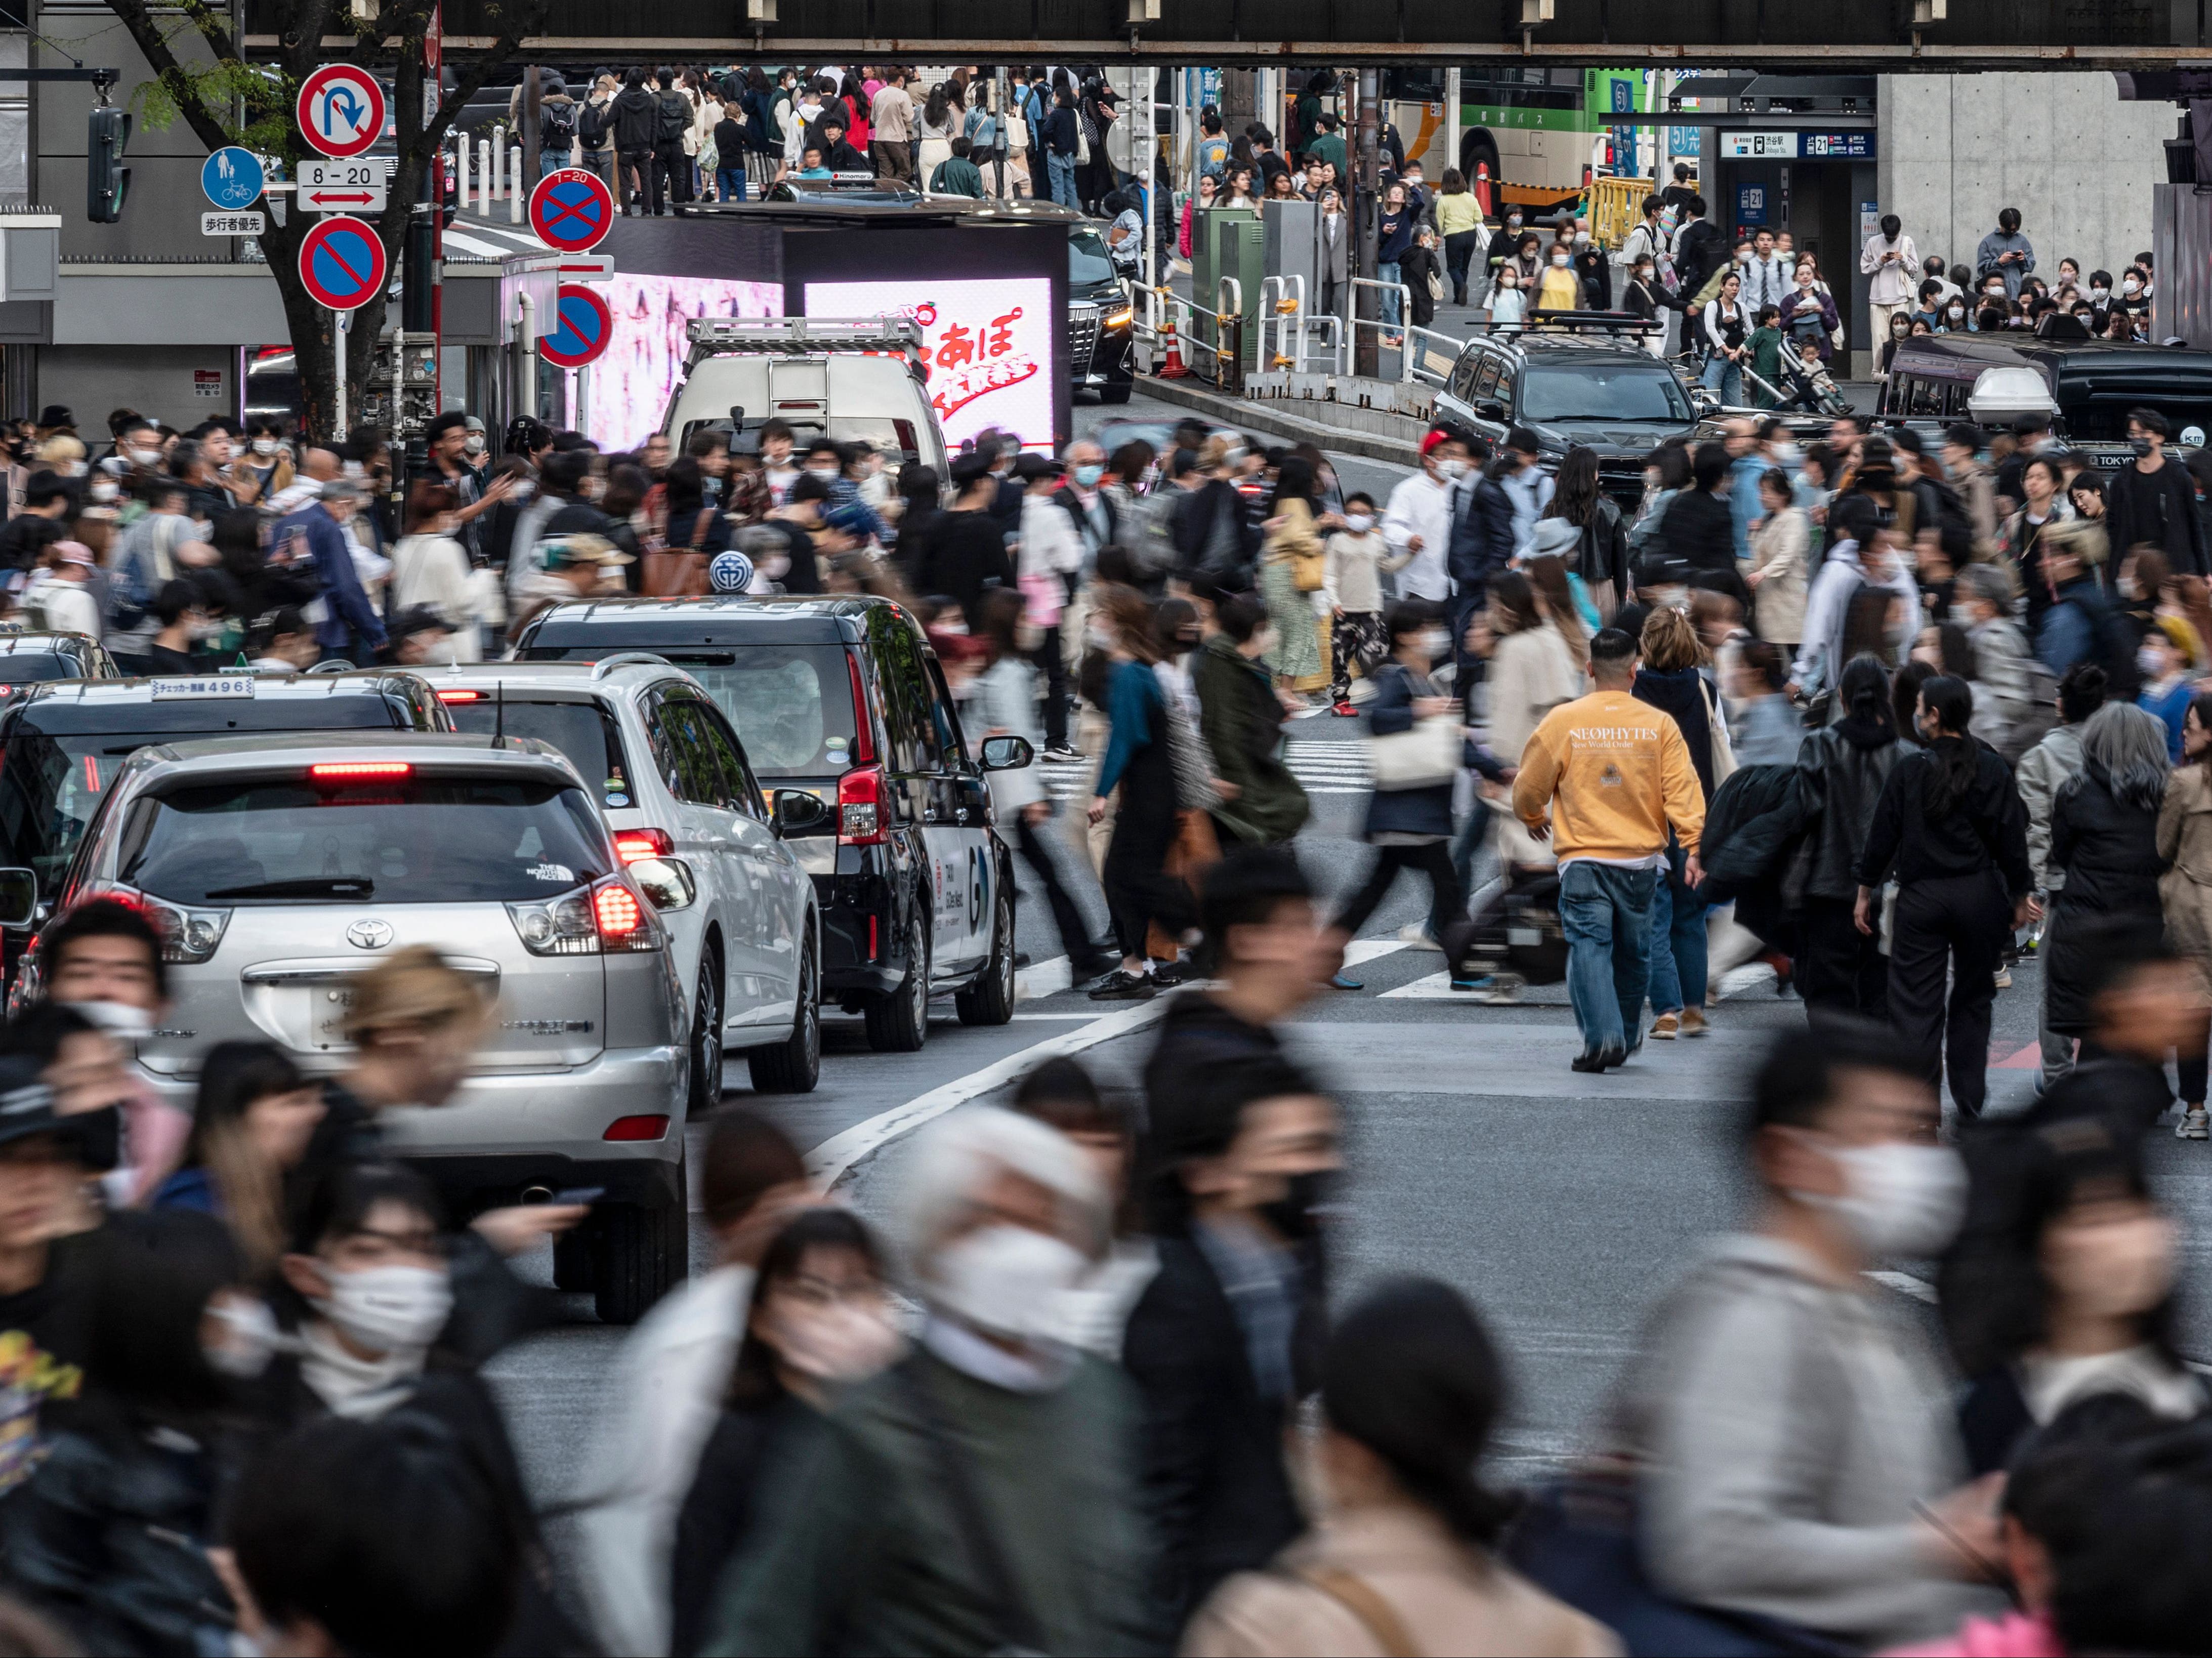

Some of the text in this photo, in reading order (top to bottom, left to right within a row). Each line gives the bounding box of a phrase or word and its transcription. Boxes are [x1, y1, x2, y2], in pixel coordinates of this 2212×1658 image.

[1766, 136, 1783, 145] 渋谷駅
[1817, 139, 1826, 151] 21
[1751, 193, 1761, 204] 21
[206, 218, 259, 231] 歩行者優先
[208, 682, 243, 692] 496
